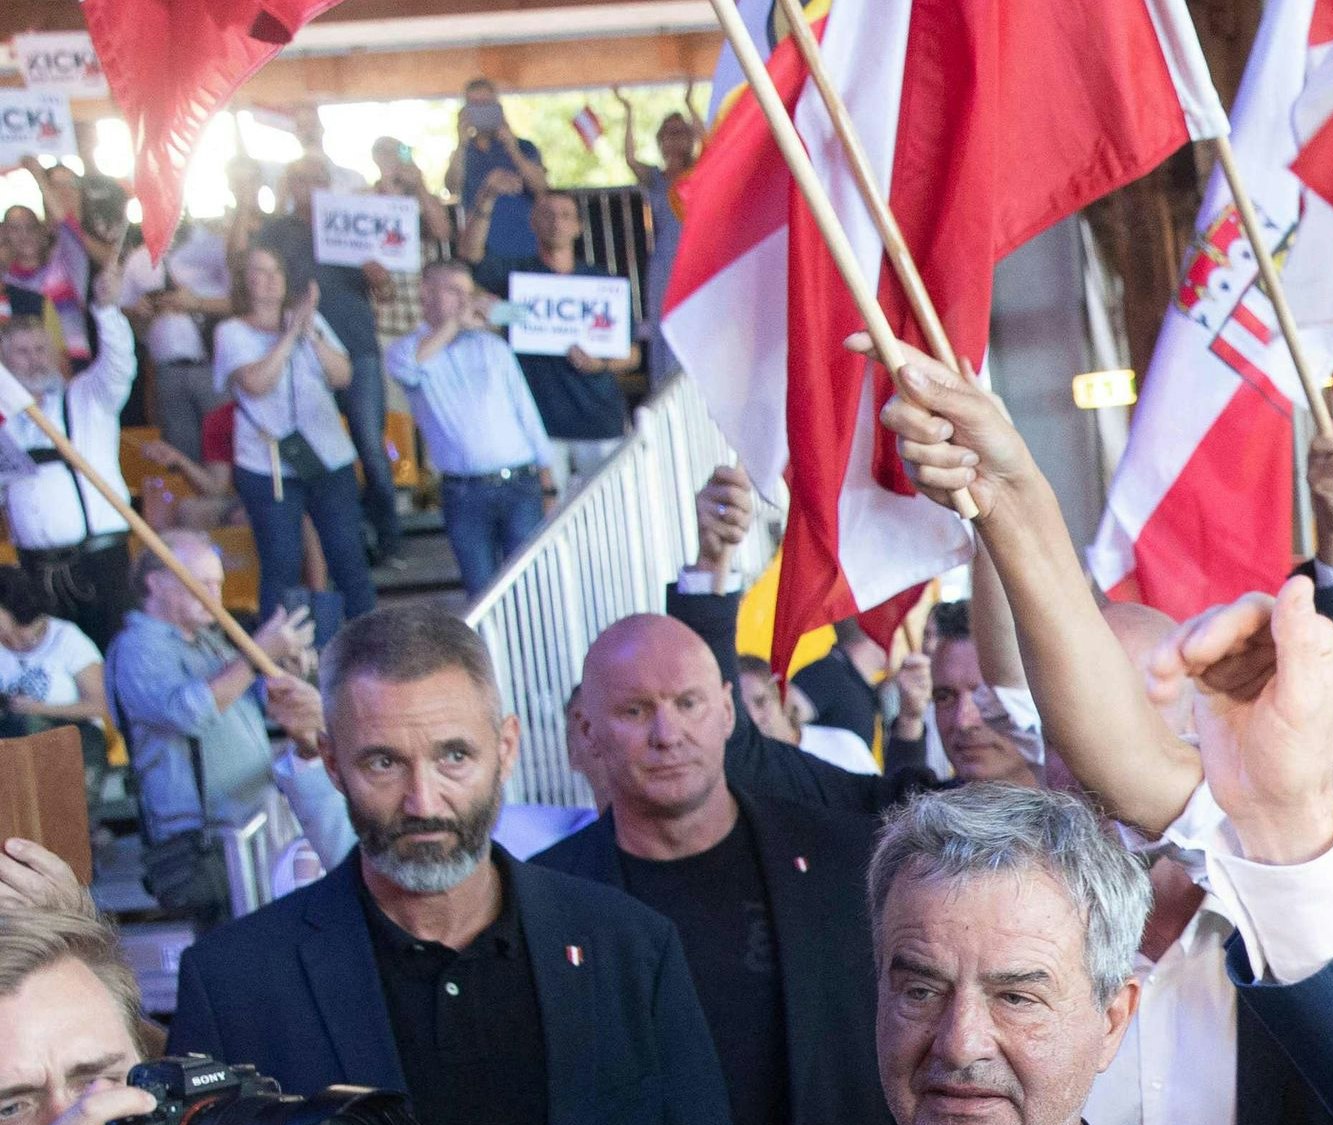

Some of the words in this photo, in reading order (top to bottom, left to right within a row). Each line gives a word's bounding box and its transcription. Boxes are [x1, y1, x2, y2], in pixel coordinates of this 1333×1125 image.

[3, 105, 60, 134] CKL
[324, 209, 406, 243] KICKL
[523, 297, 616, 326] KICKL
[192, 1071, 226, 1087] SONY
